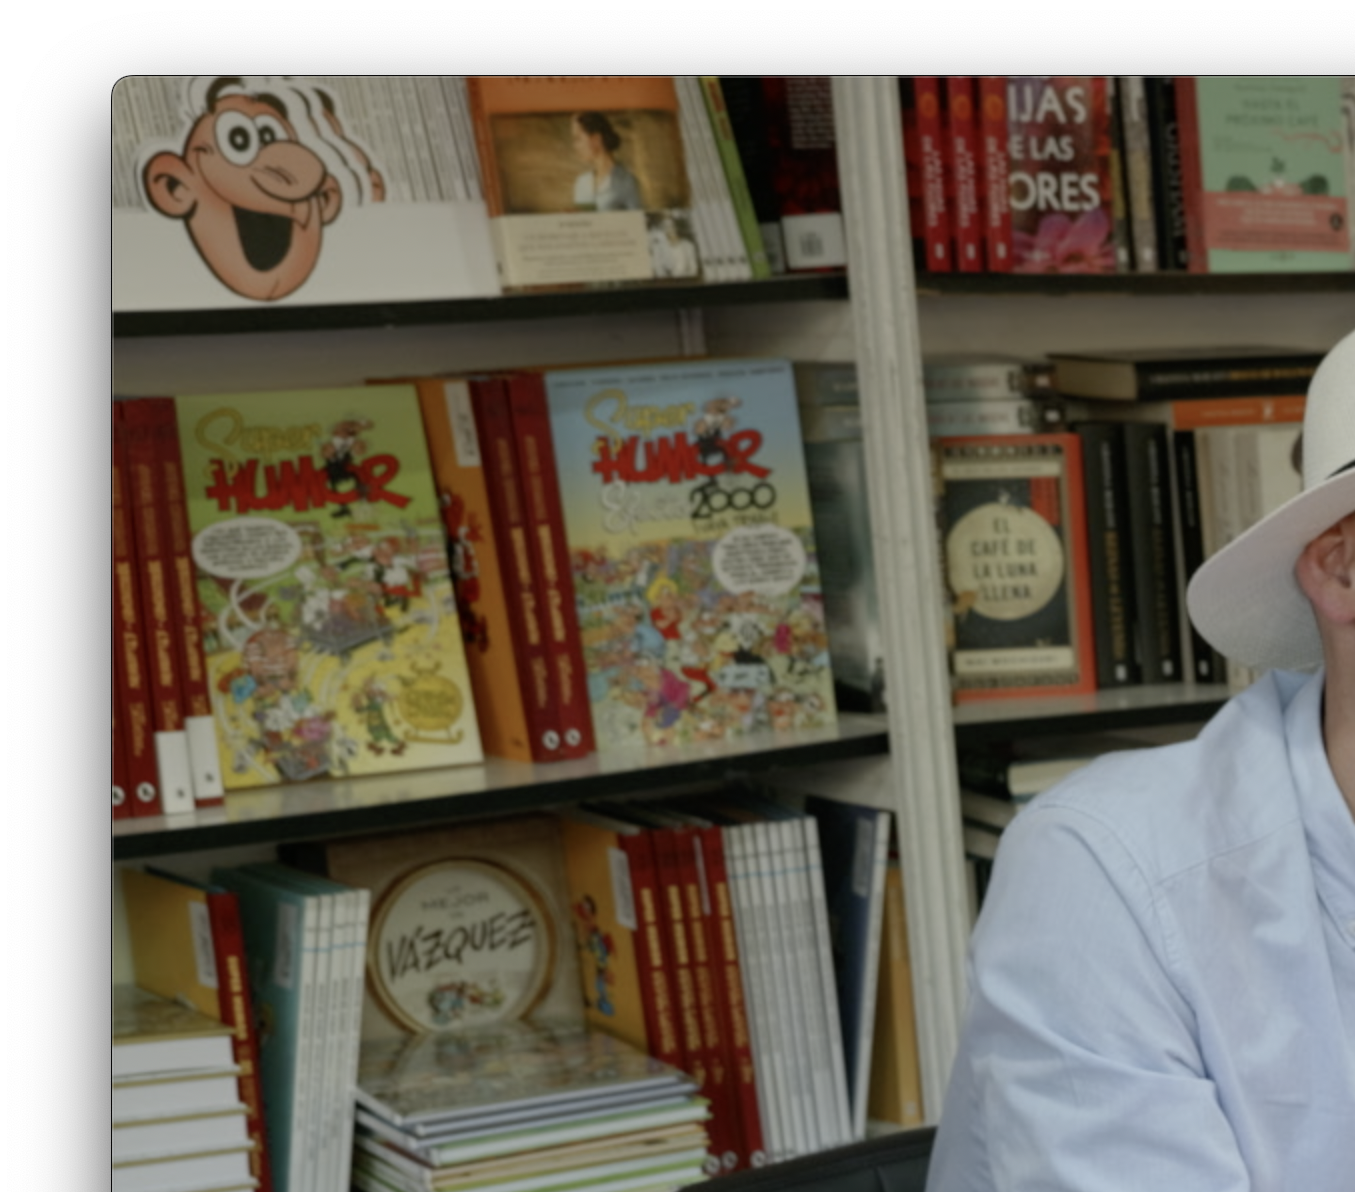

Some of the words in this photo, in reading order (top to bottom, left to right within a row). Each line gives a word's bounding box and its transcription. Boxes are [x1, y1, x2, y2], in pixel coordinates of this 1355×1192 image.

[1029, 135, 1075, 162] LAS
[1007, 172, 1100, 213] ORES
[689, 481, 777, 520] 2000
[992, 516, 1013, 535] EL
[1016, 538, 1037, 557] DE
[972, 561, 991, 581] LA
[386, 908, 537, 984] VÁZQUEZ
